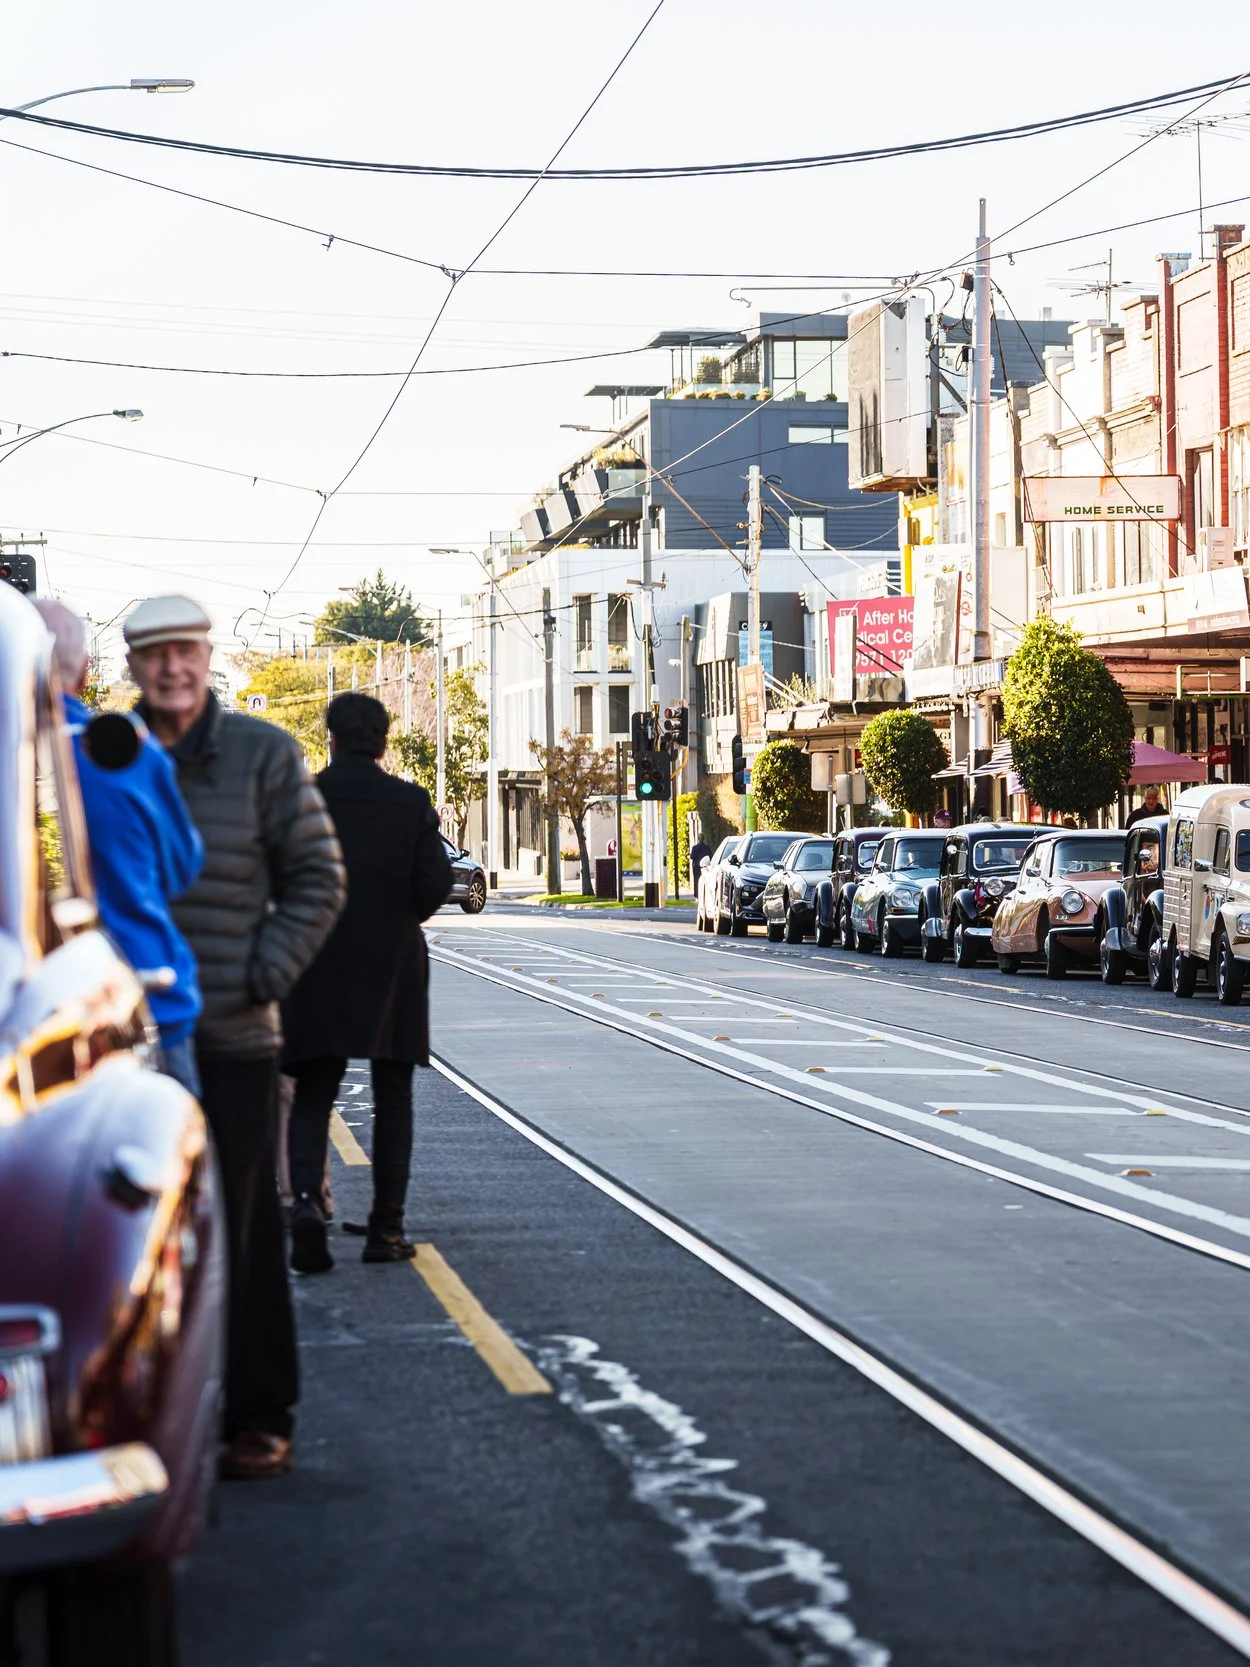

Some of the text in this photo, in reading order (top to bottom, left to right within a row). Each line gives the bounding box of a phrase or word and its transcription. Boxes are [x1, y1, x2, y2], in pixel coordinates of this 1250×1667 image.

[1064, 505, 1164, 515] HOME SERVICE
[863, 610, 894, 626] After
[856, 630, 889, 646] dical
